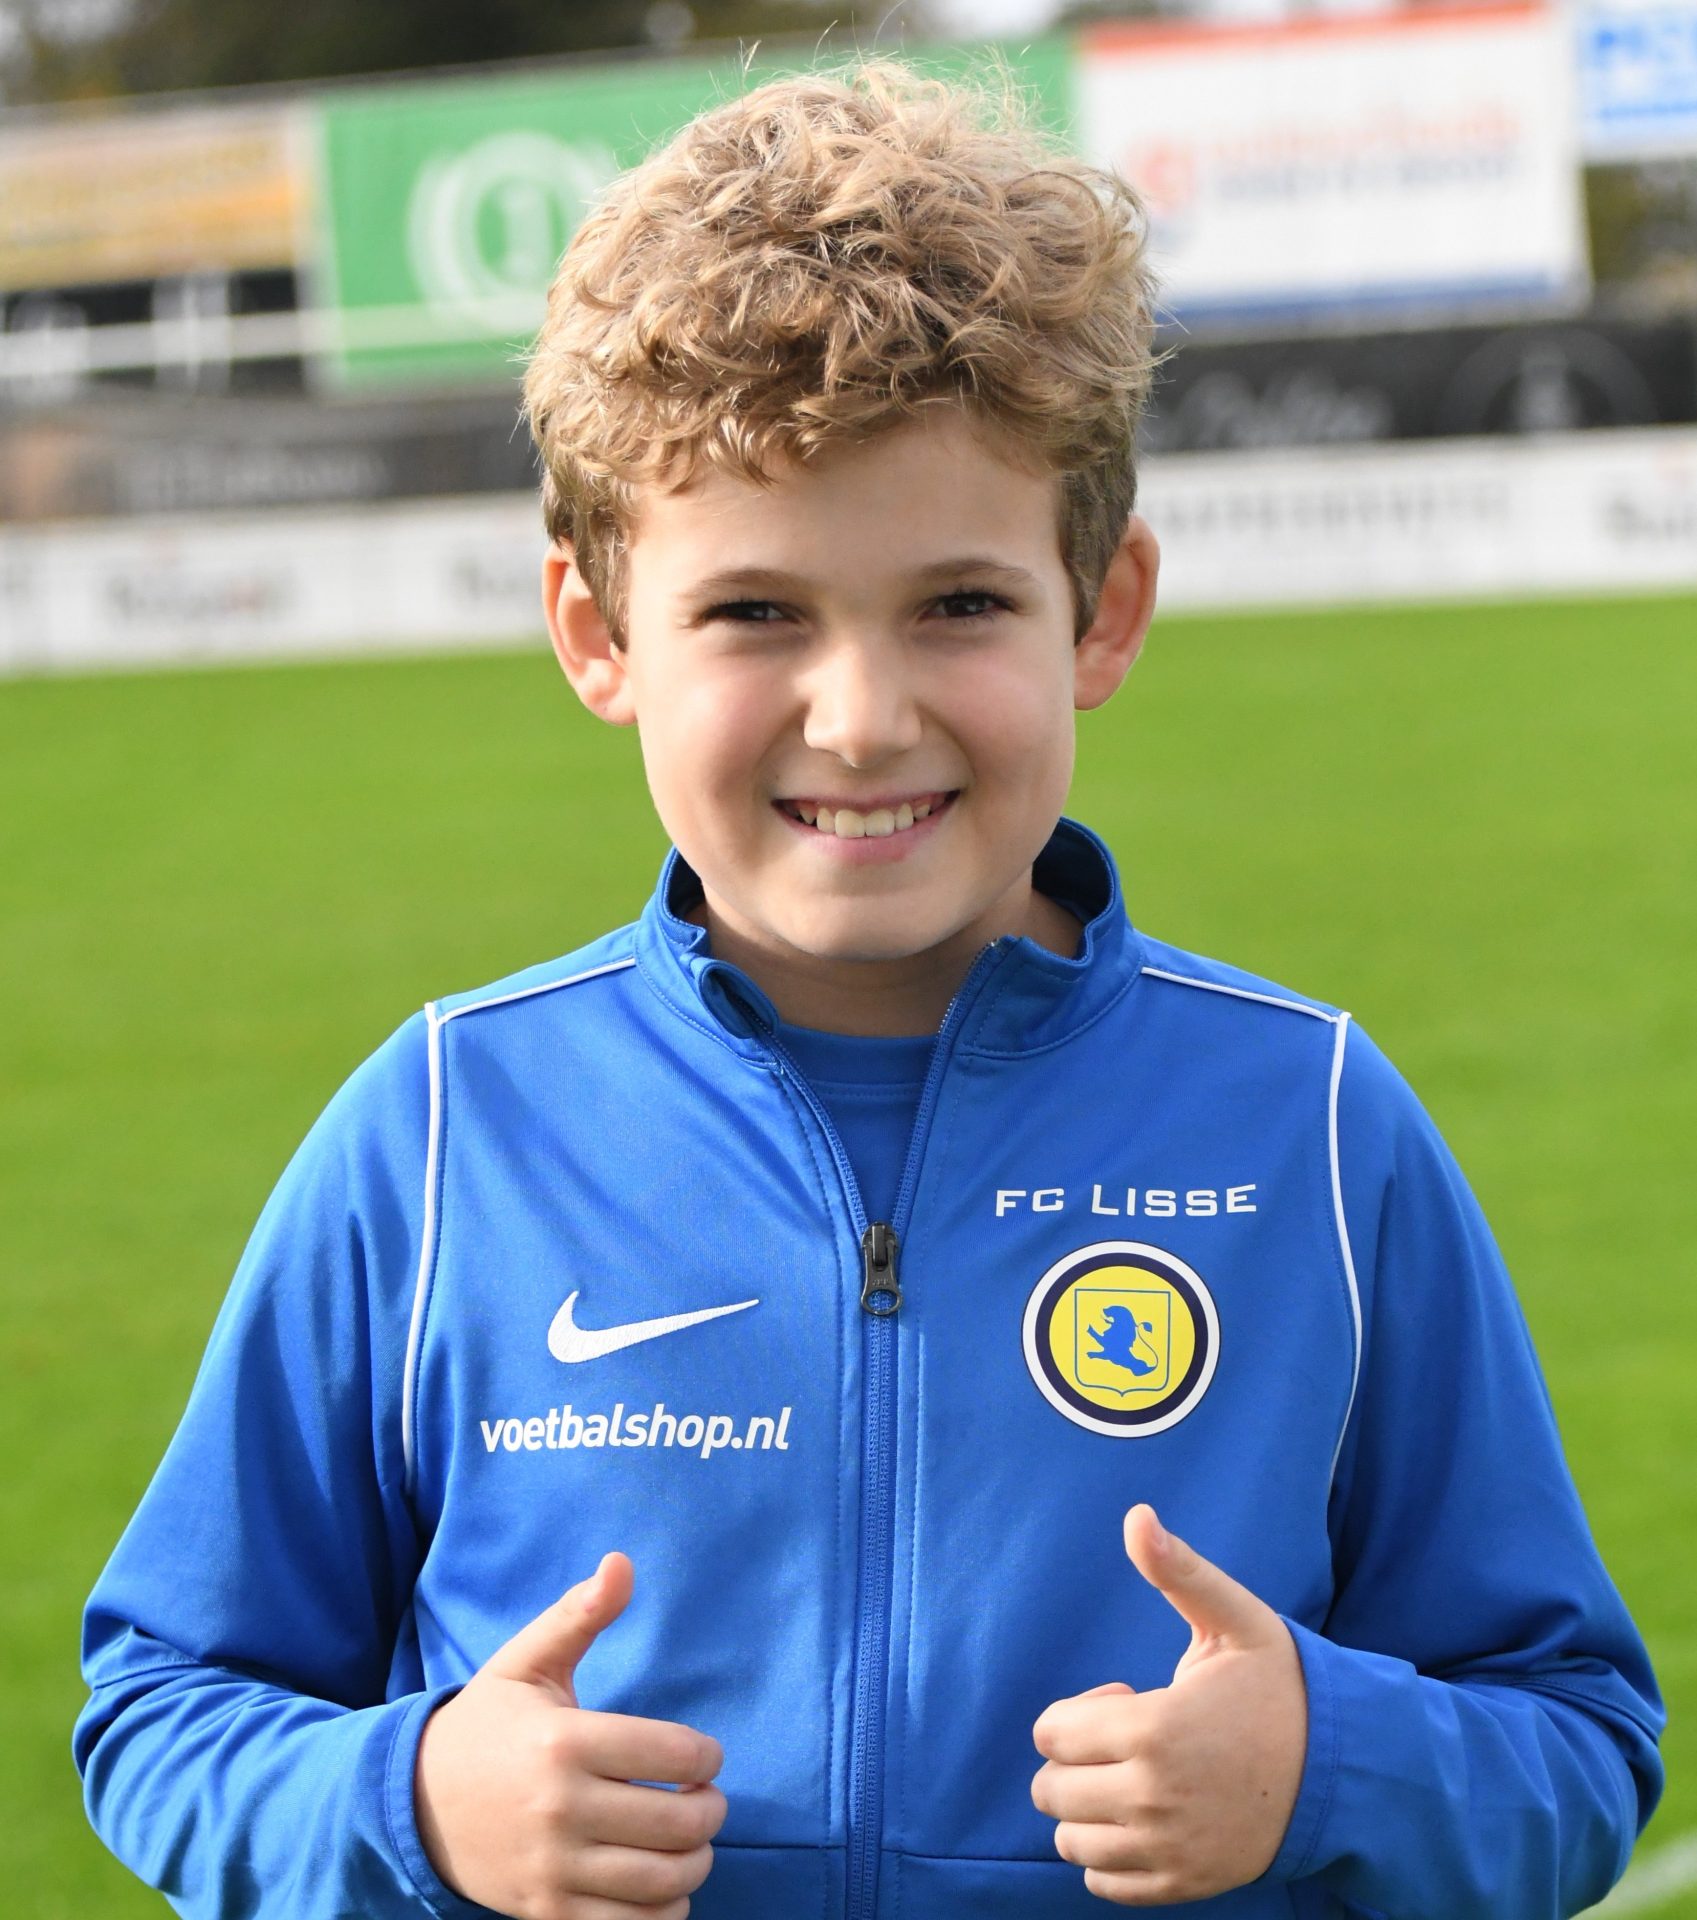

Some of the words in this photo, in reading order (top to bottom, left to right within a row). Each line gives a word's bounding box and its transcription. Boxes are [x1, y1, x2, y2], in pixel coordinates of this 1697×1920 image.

[995, 1187, 1065, 1217] FC
[1091, 1183, 1257, 1217] LISSE
[480, 1403, 792, 1459] voetbalshop.nl
